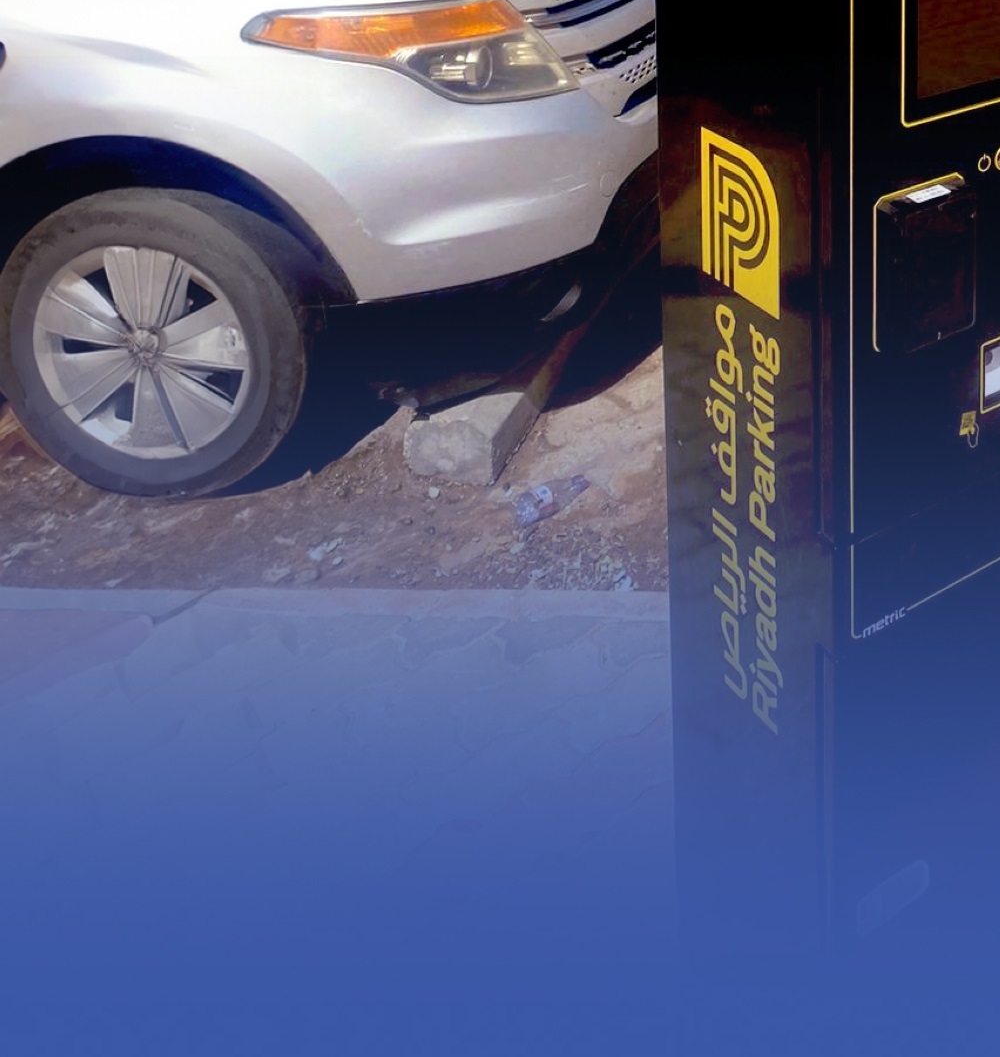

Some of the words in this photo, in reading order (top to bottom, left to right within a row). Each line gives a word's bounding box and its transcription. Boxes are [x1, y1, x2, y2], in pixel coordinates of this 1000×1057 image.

[705, 303, 743, 505] مواقف
[746, 323, 780, 542] Parking
[749, 545, 783, 735] Riyadh
[862, 606, 906, 639] metric
